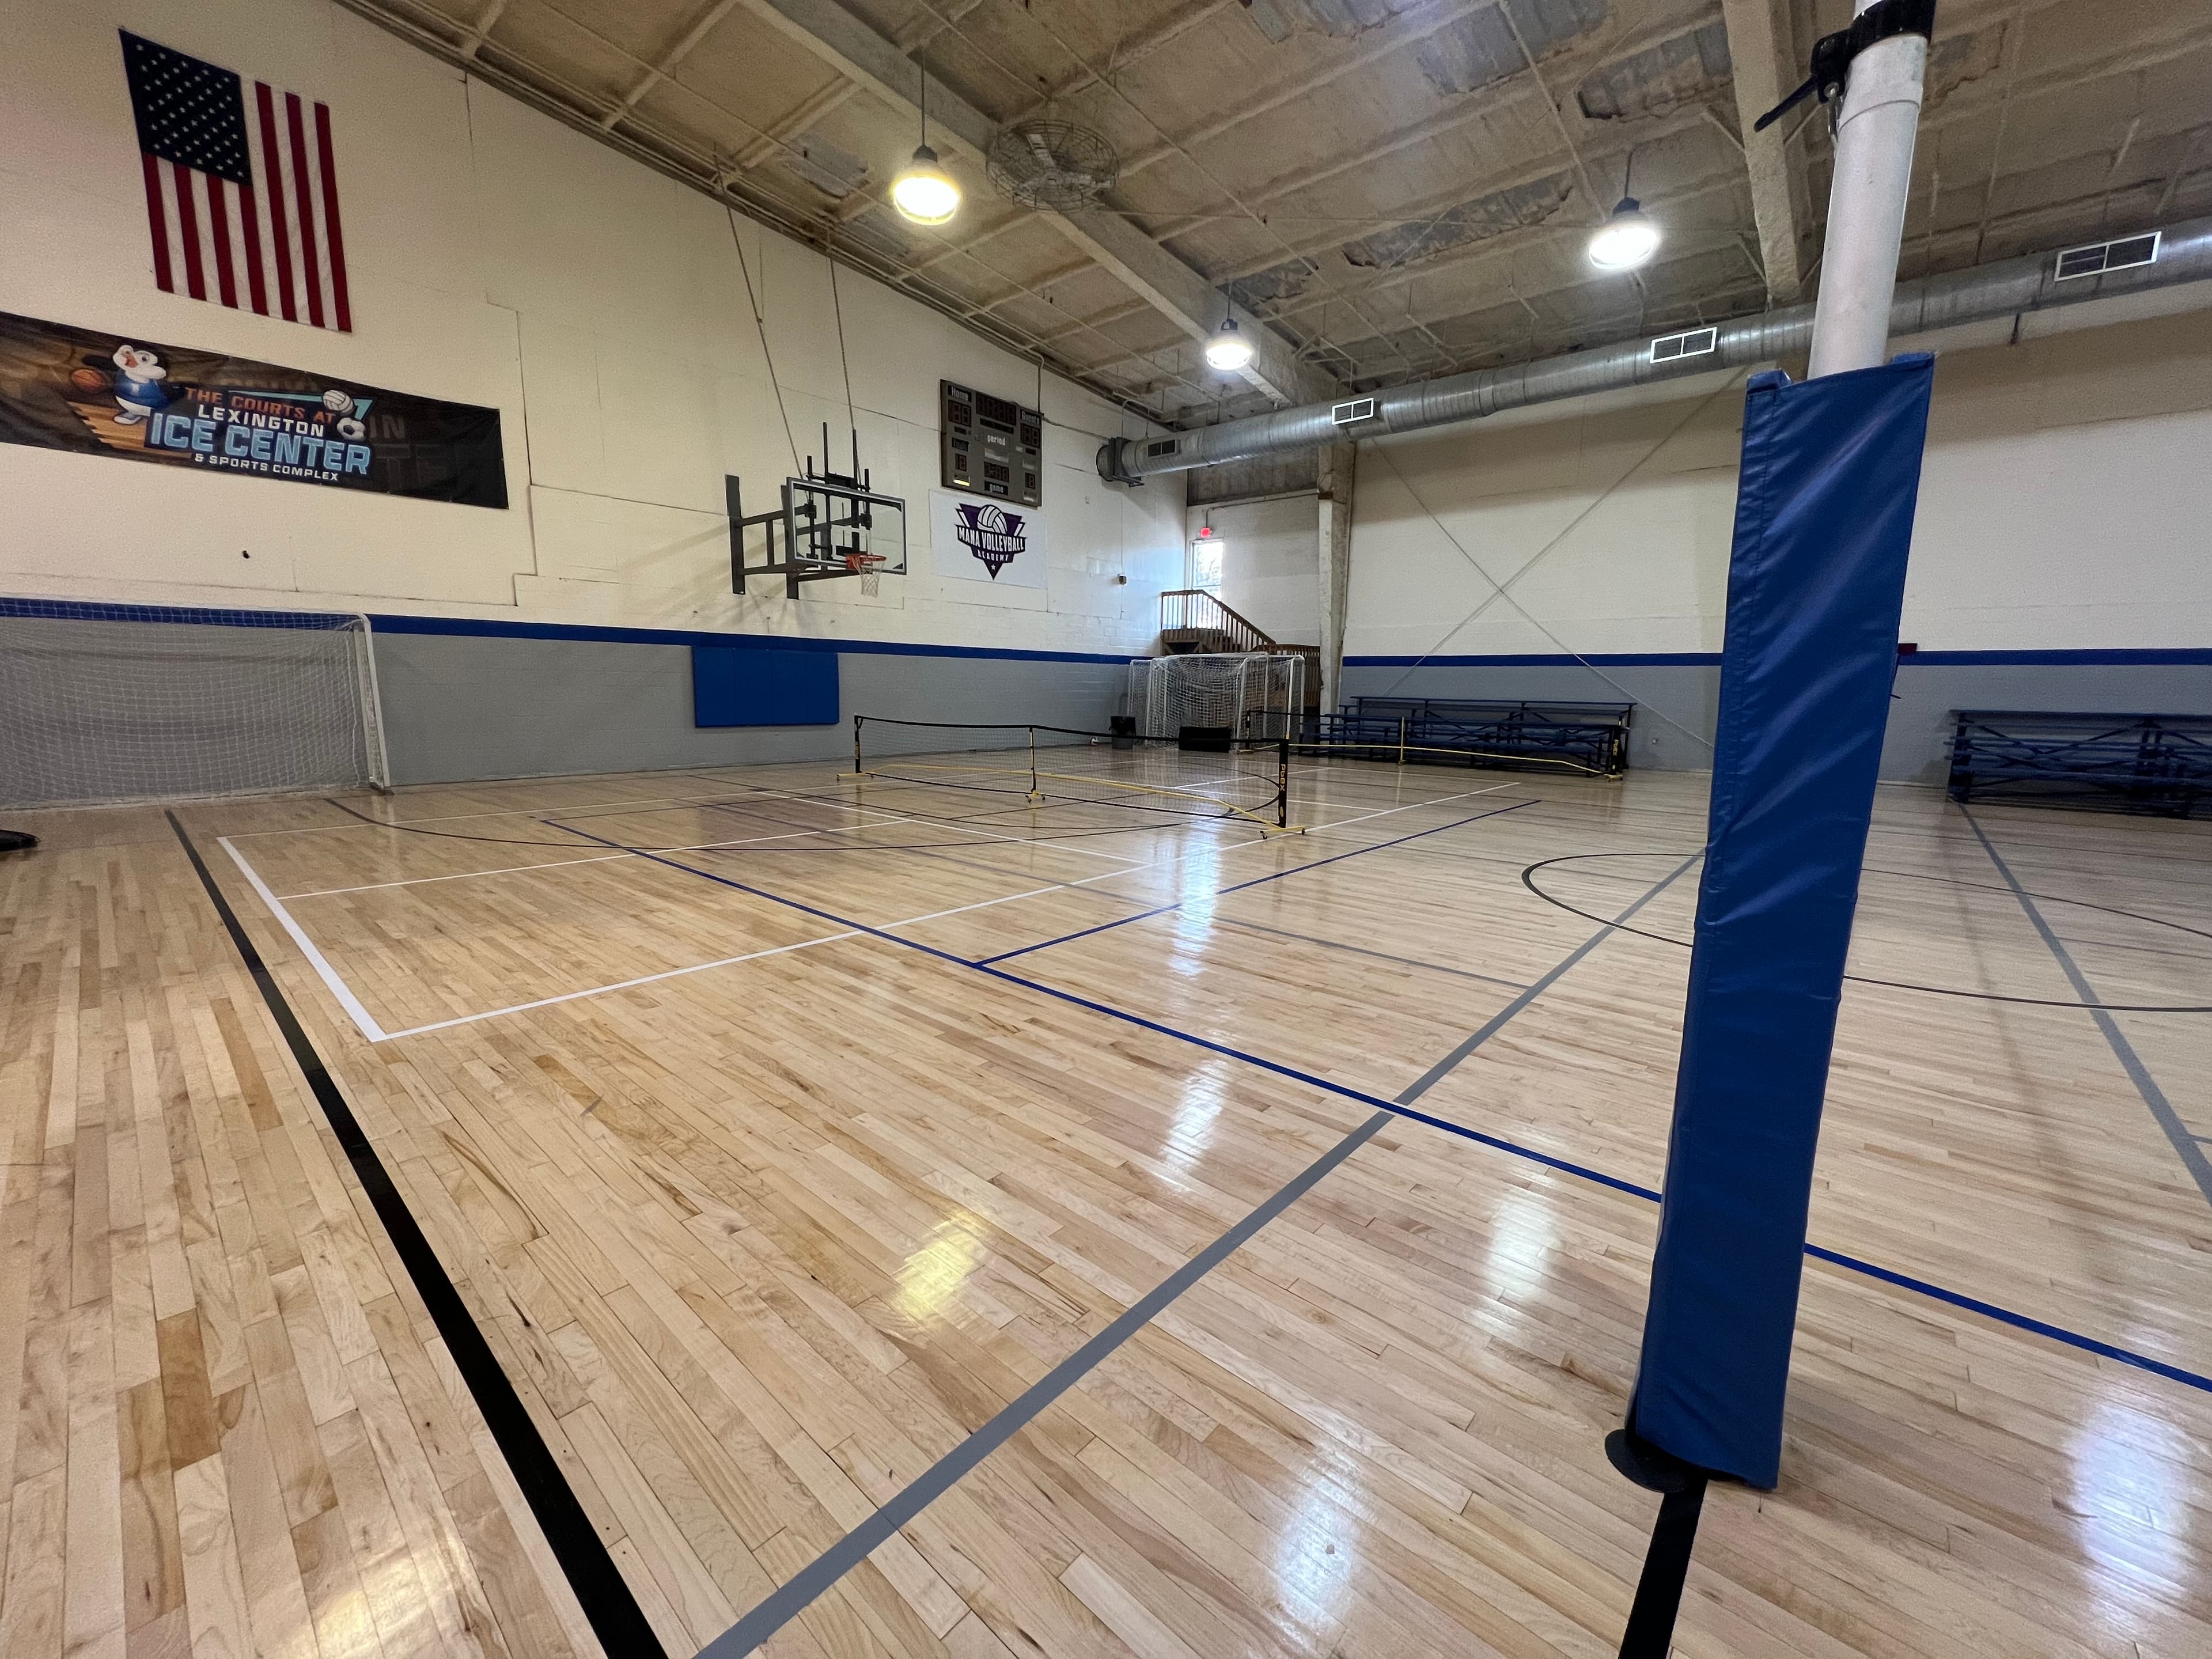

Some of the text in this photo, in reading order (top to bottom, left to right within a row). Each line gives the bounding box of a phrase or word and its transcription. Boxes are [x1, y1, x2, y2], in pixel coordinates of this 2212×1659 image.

[185, 387, 336, 424] THE COURTS AT
[951, 387, 968, 401] Home
[198, 404, 324, 437] LEXINGTON
[151, 412, 370, 475] ICE CENTER
[987, 434, 1006, 446] period
[194, 453, 338, 481] & SPORTS COMPLEX
[981, 531, 1024, 552] VOLLEYBALL
[978, 549, 1009, 562] ACADEMY
